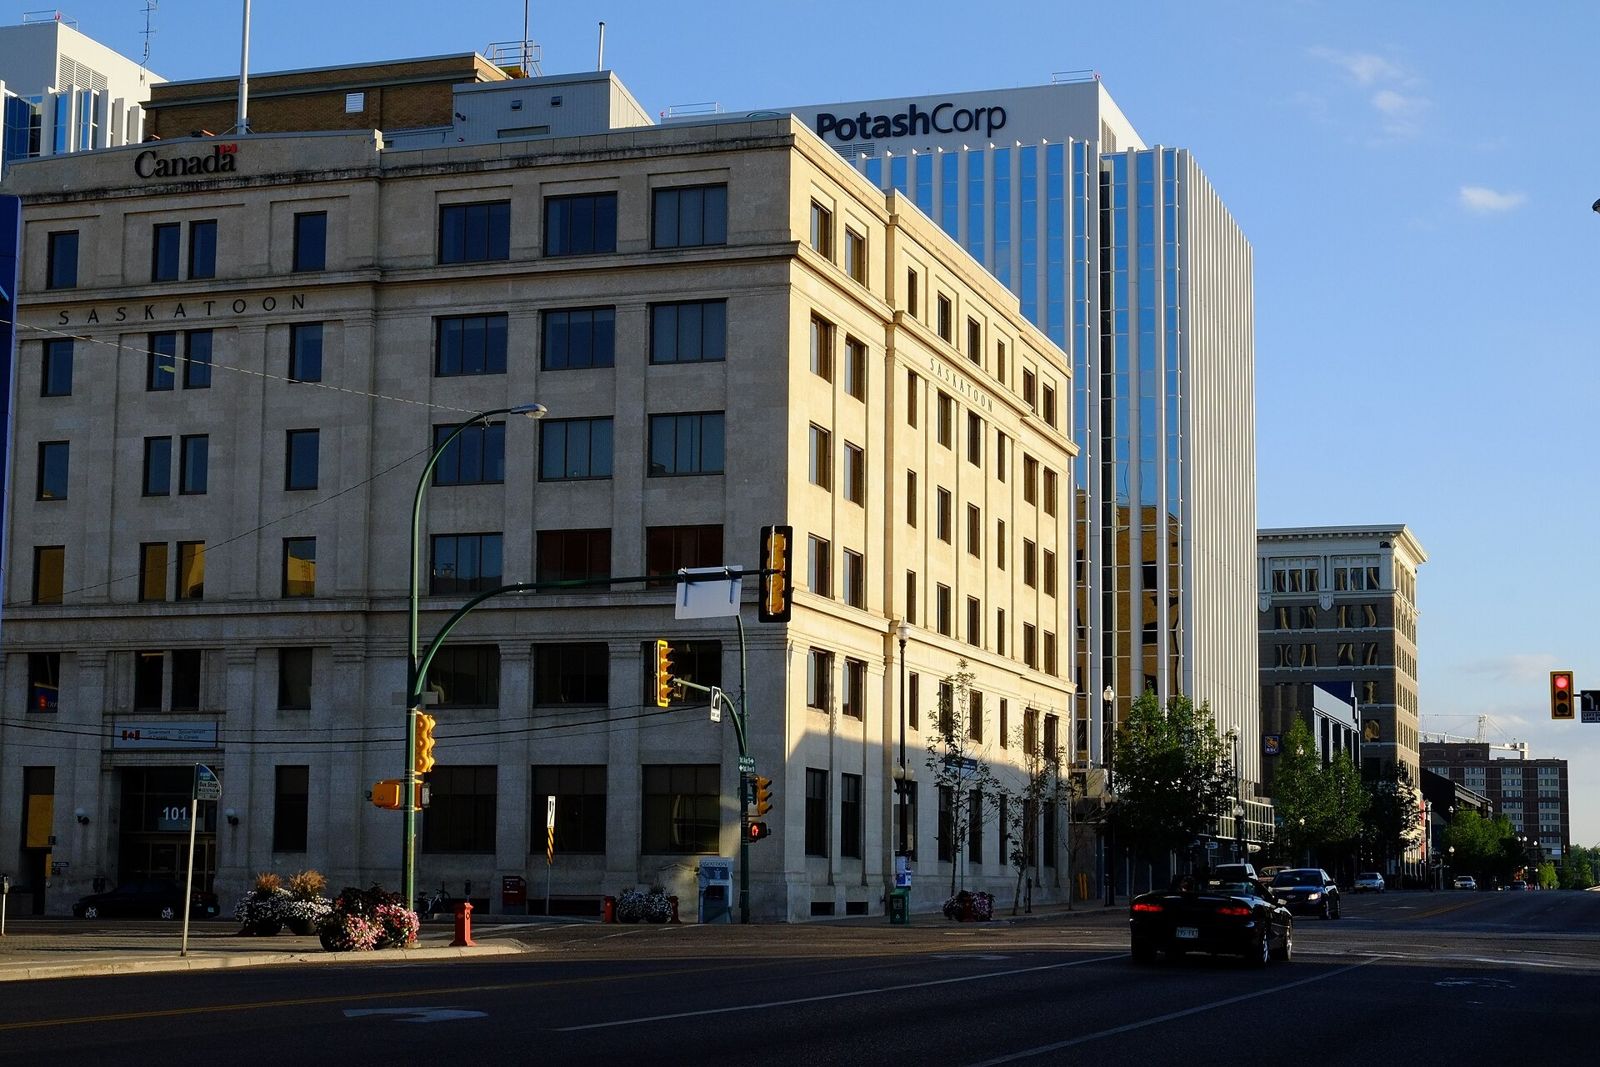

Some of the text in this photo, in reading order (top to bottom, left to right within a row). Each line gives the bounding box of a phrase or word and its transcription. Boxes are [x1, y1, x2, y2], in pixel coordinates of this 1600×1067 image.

[816, 102, 1007, 141] PotashCorp
[134, 145, 237, 179] Canada
[59, 294, 305, 325] SASKATOON
[930, 358, 993, 413] SASKATOON
[163, 806, 187, 821] 101
